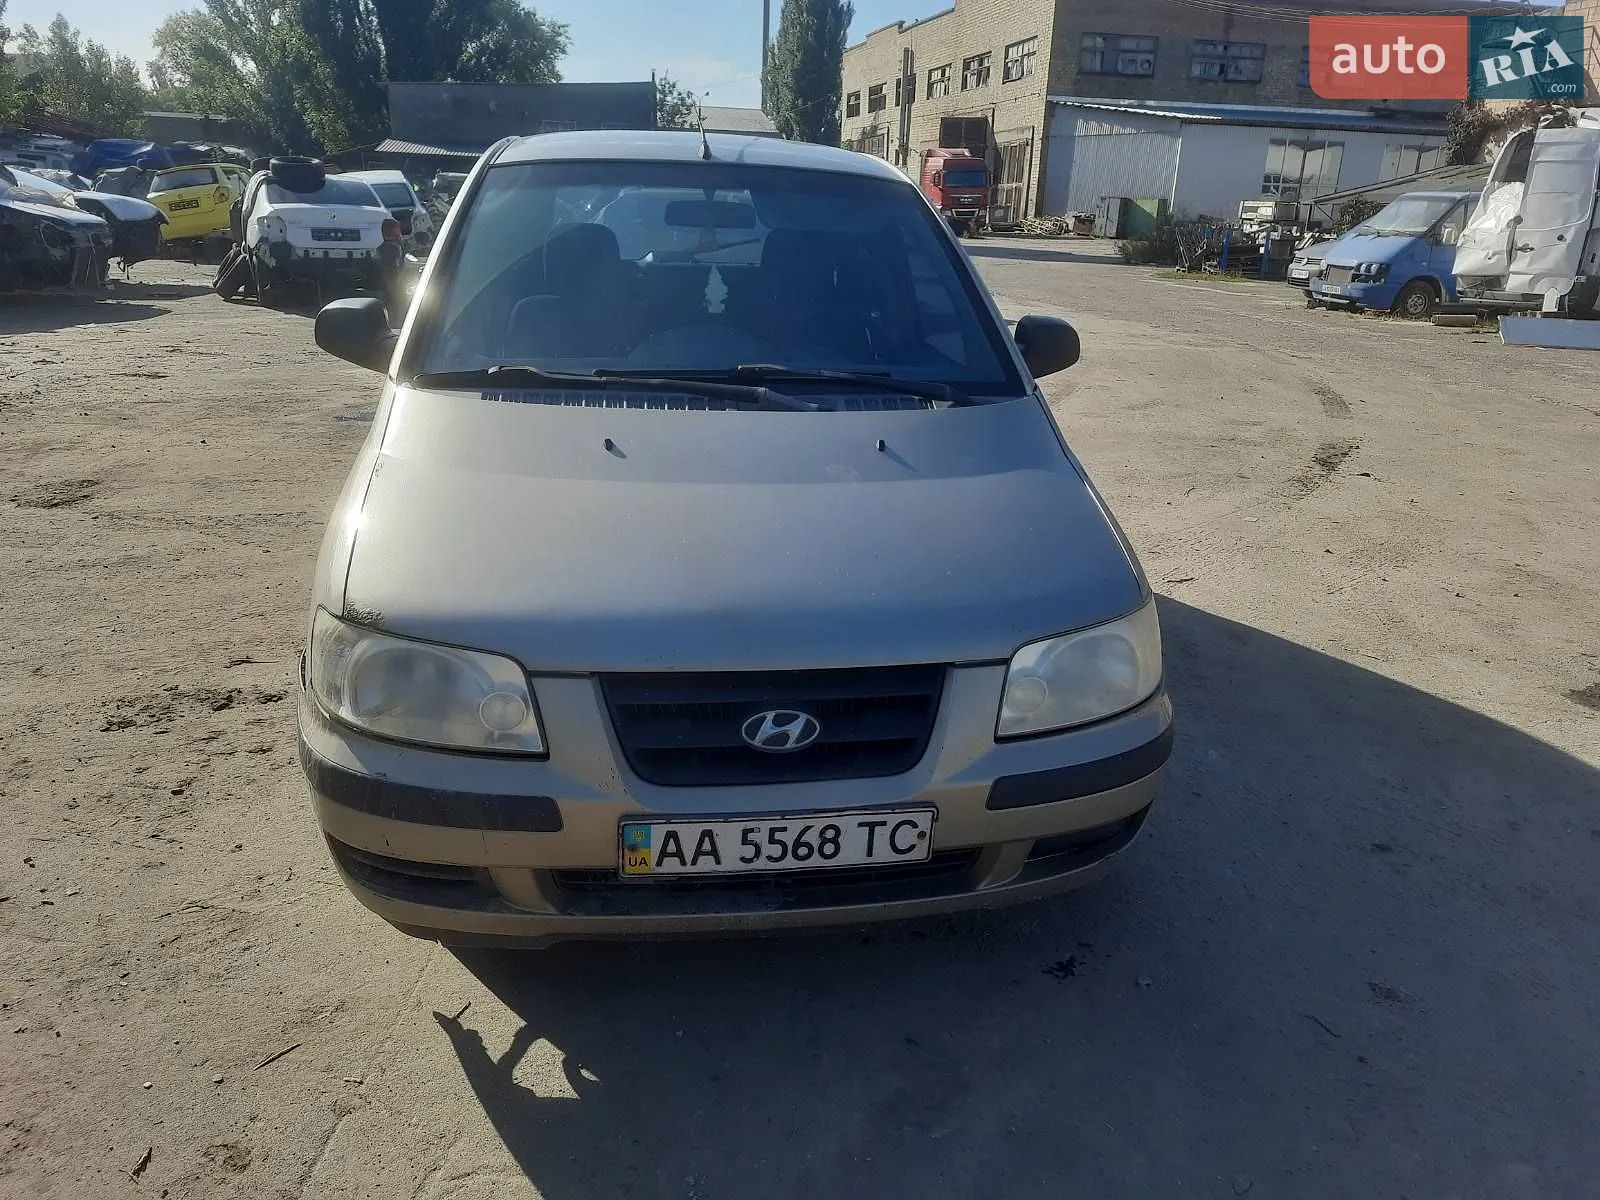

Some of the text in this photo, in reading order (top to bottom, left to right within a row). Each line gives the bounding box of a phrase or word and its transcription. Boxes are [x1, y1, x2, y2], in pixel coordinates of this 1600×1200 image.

[655, 820, 919, 867] AA 5568 TC
[628, 856, 649, 868] UA
